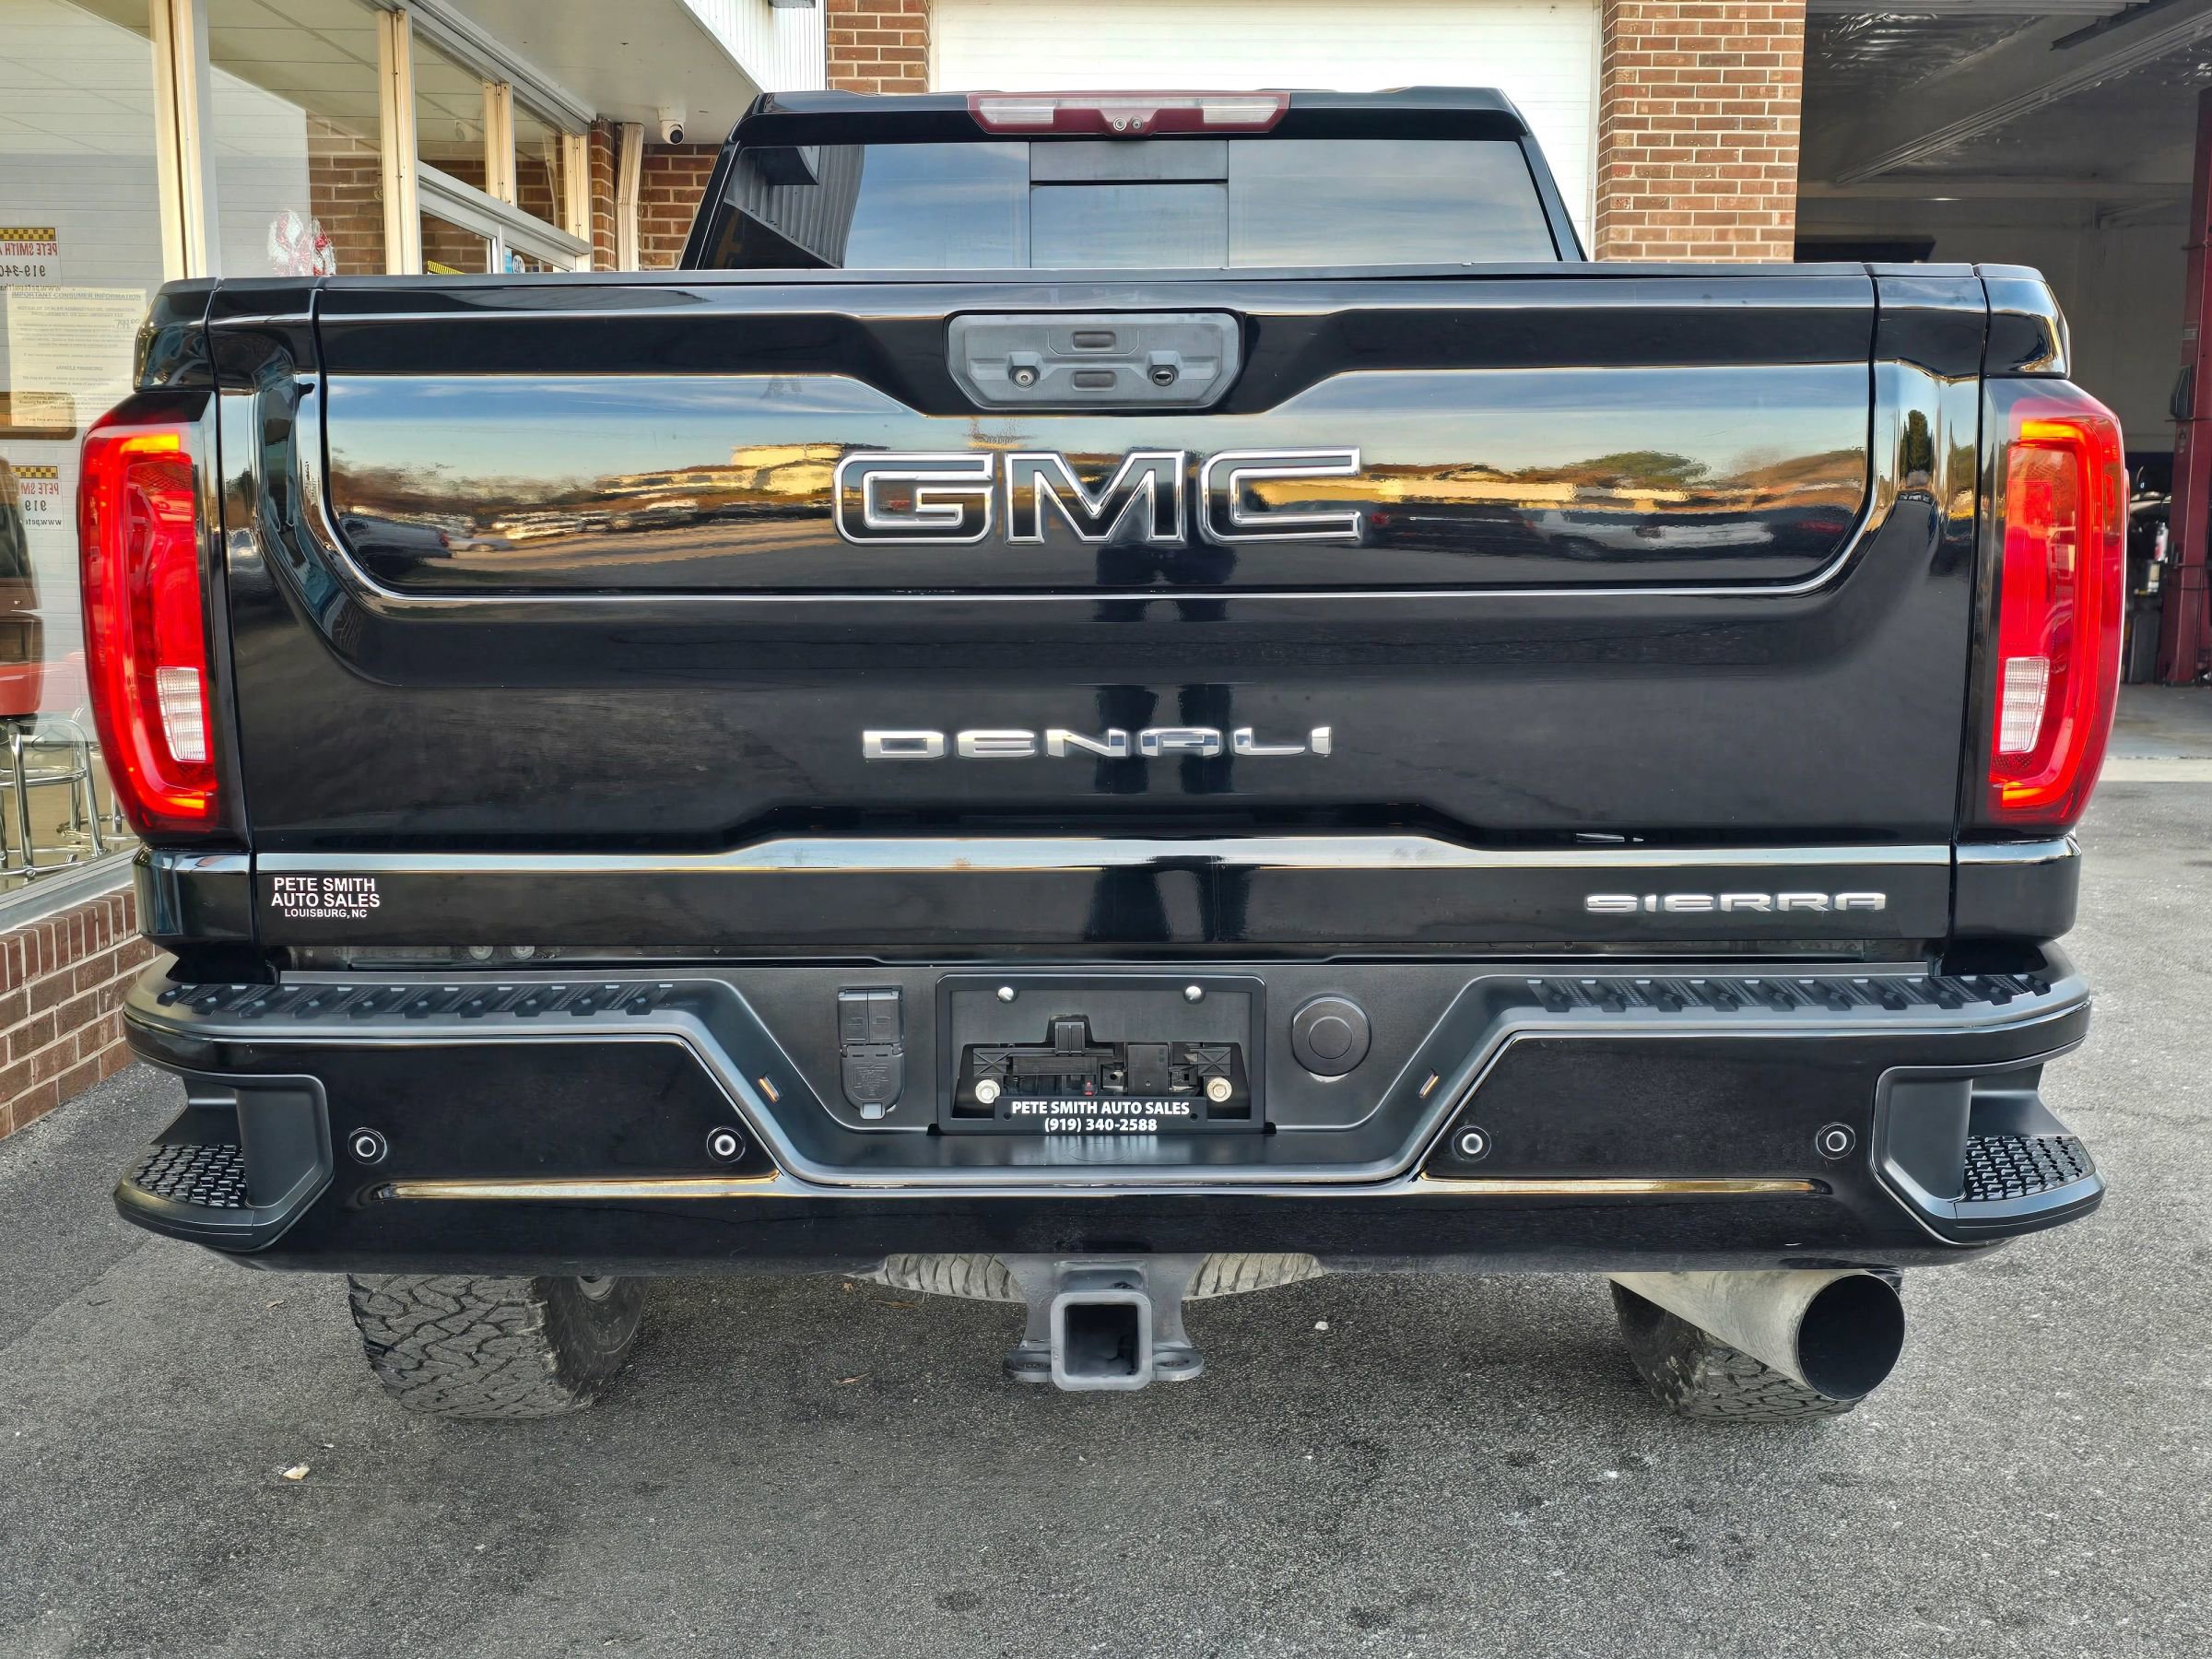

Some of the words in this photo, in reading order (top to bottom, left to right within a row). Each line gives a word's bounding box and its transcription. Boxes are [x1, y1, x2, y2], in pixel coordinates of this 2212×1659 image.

[833, 447, 1361, 545] GMC
[863, 726, 1333, 759] DENALI
[274, 877, 318, 891] PETE
[323, 877, 376, 892] SMITH
[271, 892, 319, 907] AUTO
[324, 893, 381, 908] SALES
[1585, 892, 1887, 913] SIERRA
[284, 908, 350, 919] LOUISBURG,
[351, 909, 368, 918] NC
[1012, 1100, 1049, 1115] PETE
[1050, 1100, 1098, 1115] SMITH
[1100, 1100, 1143, 1115] AUTO
[1145, 1100, 1191, 1115] SALES
[1044, 1118, 1082, 1133] (919)
[1086, 1118, 1158, 1132] 340-2588
